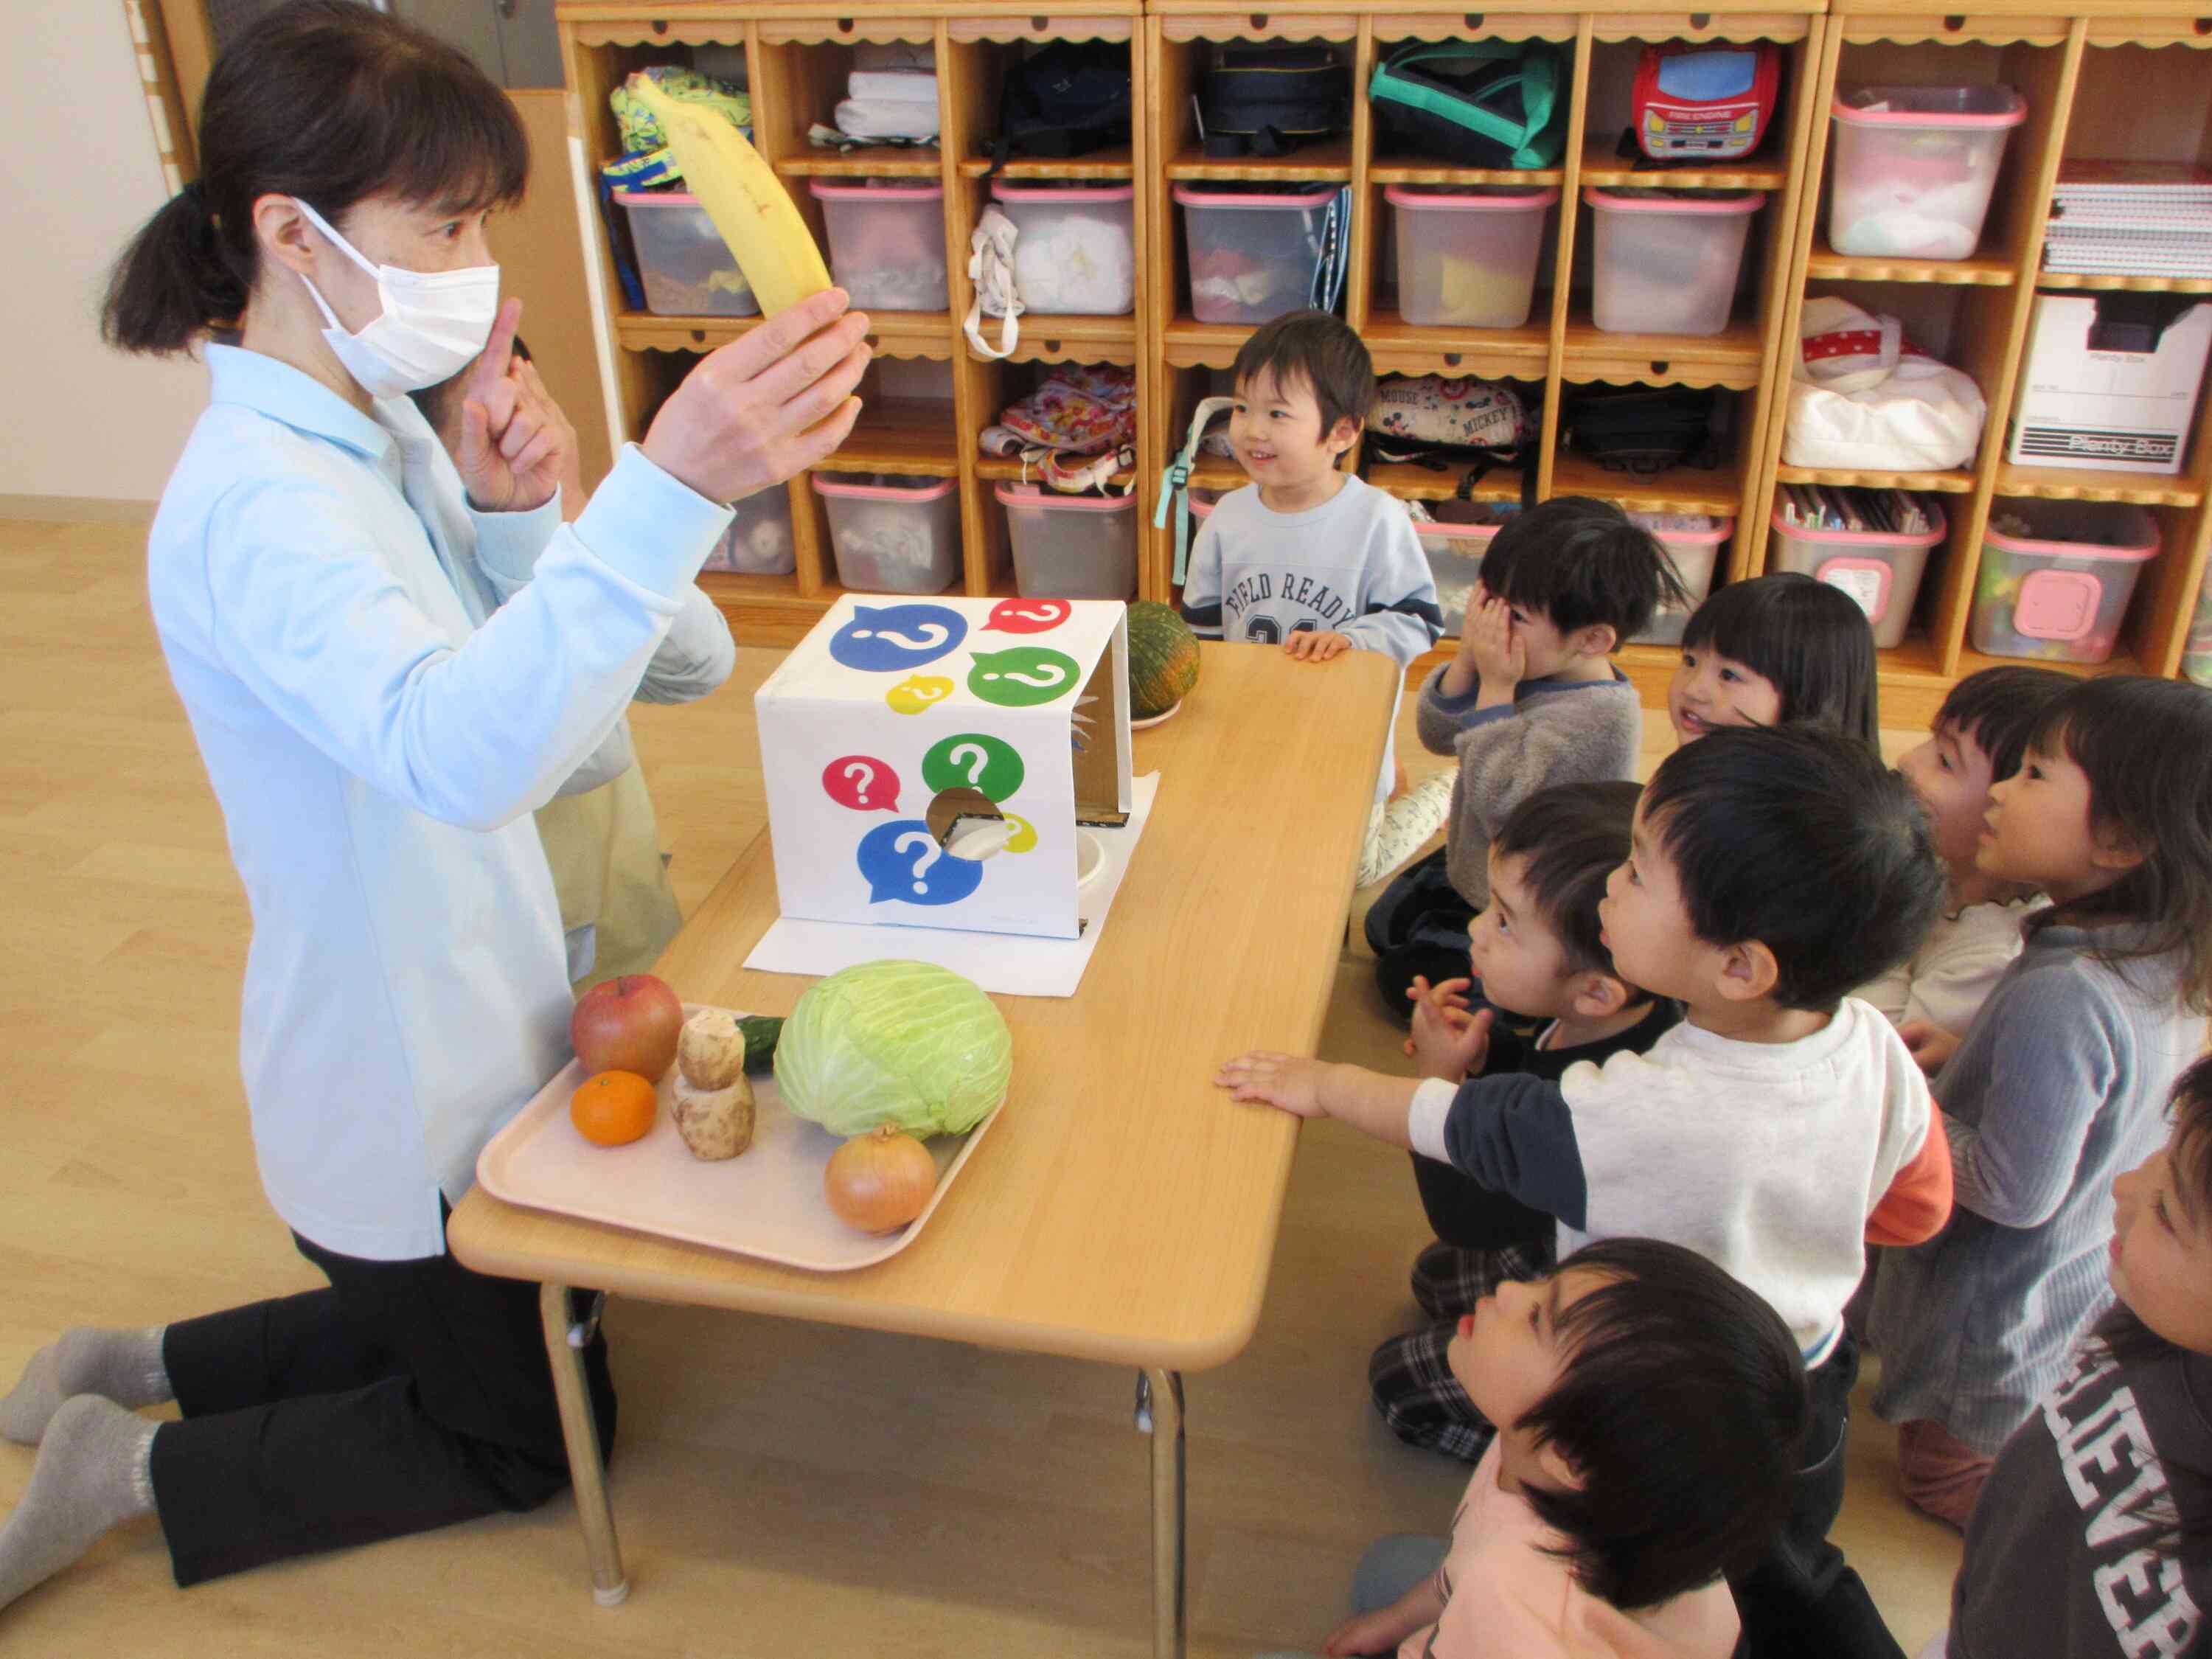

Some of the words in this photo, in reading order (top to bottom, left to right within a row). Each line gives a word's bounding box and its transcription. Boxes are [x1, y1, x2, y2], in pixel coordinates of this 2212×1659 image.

[1380, 389, 1418, 405] MOUSE
[1462, 407, 1509, 437] MICKEY
[2067, 435, 2127, 456] Plenty
[2135, 437, 2175, 456] Box
[1225, 572, 1272, 619] FIELD
[1280, 572, 1356, 630] READY
